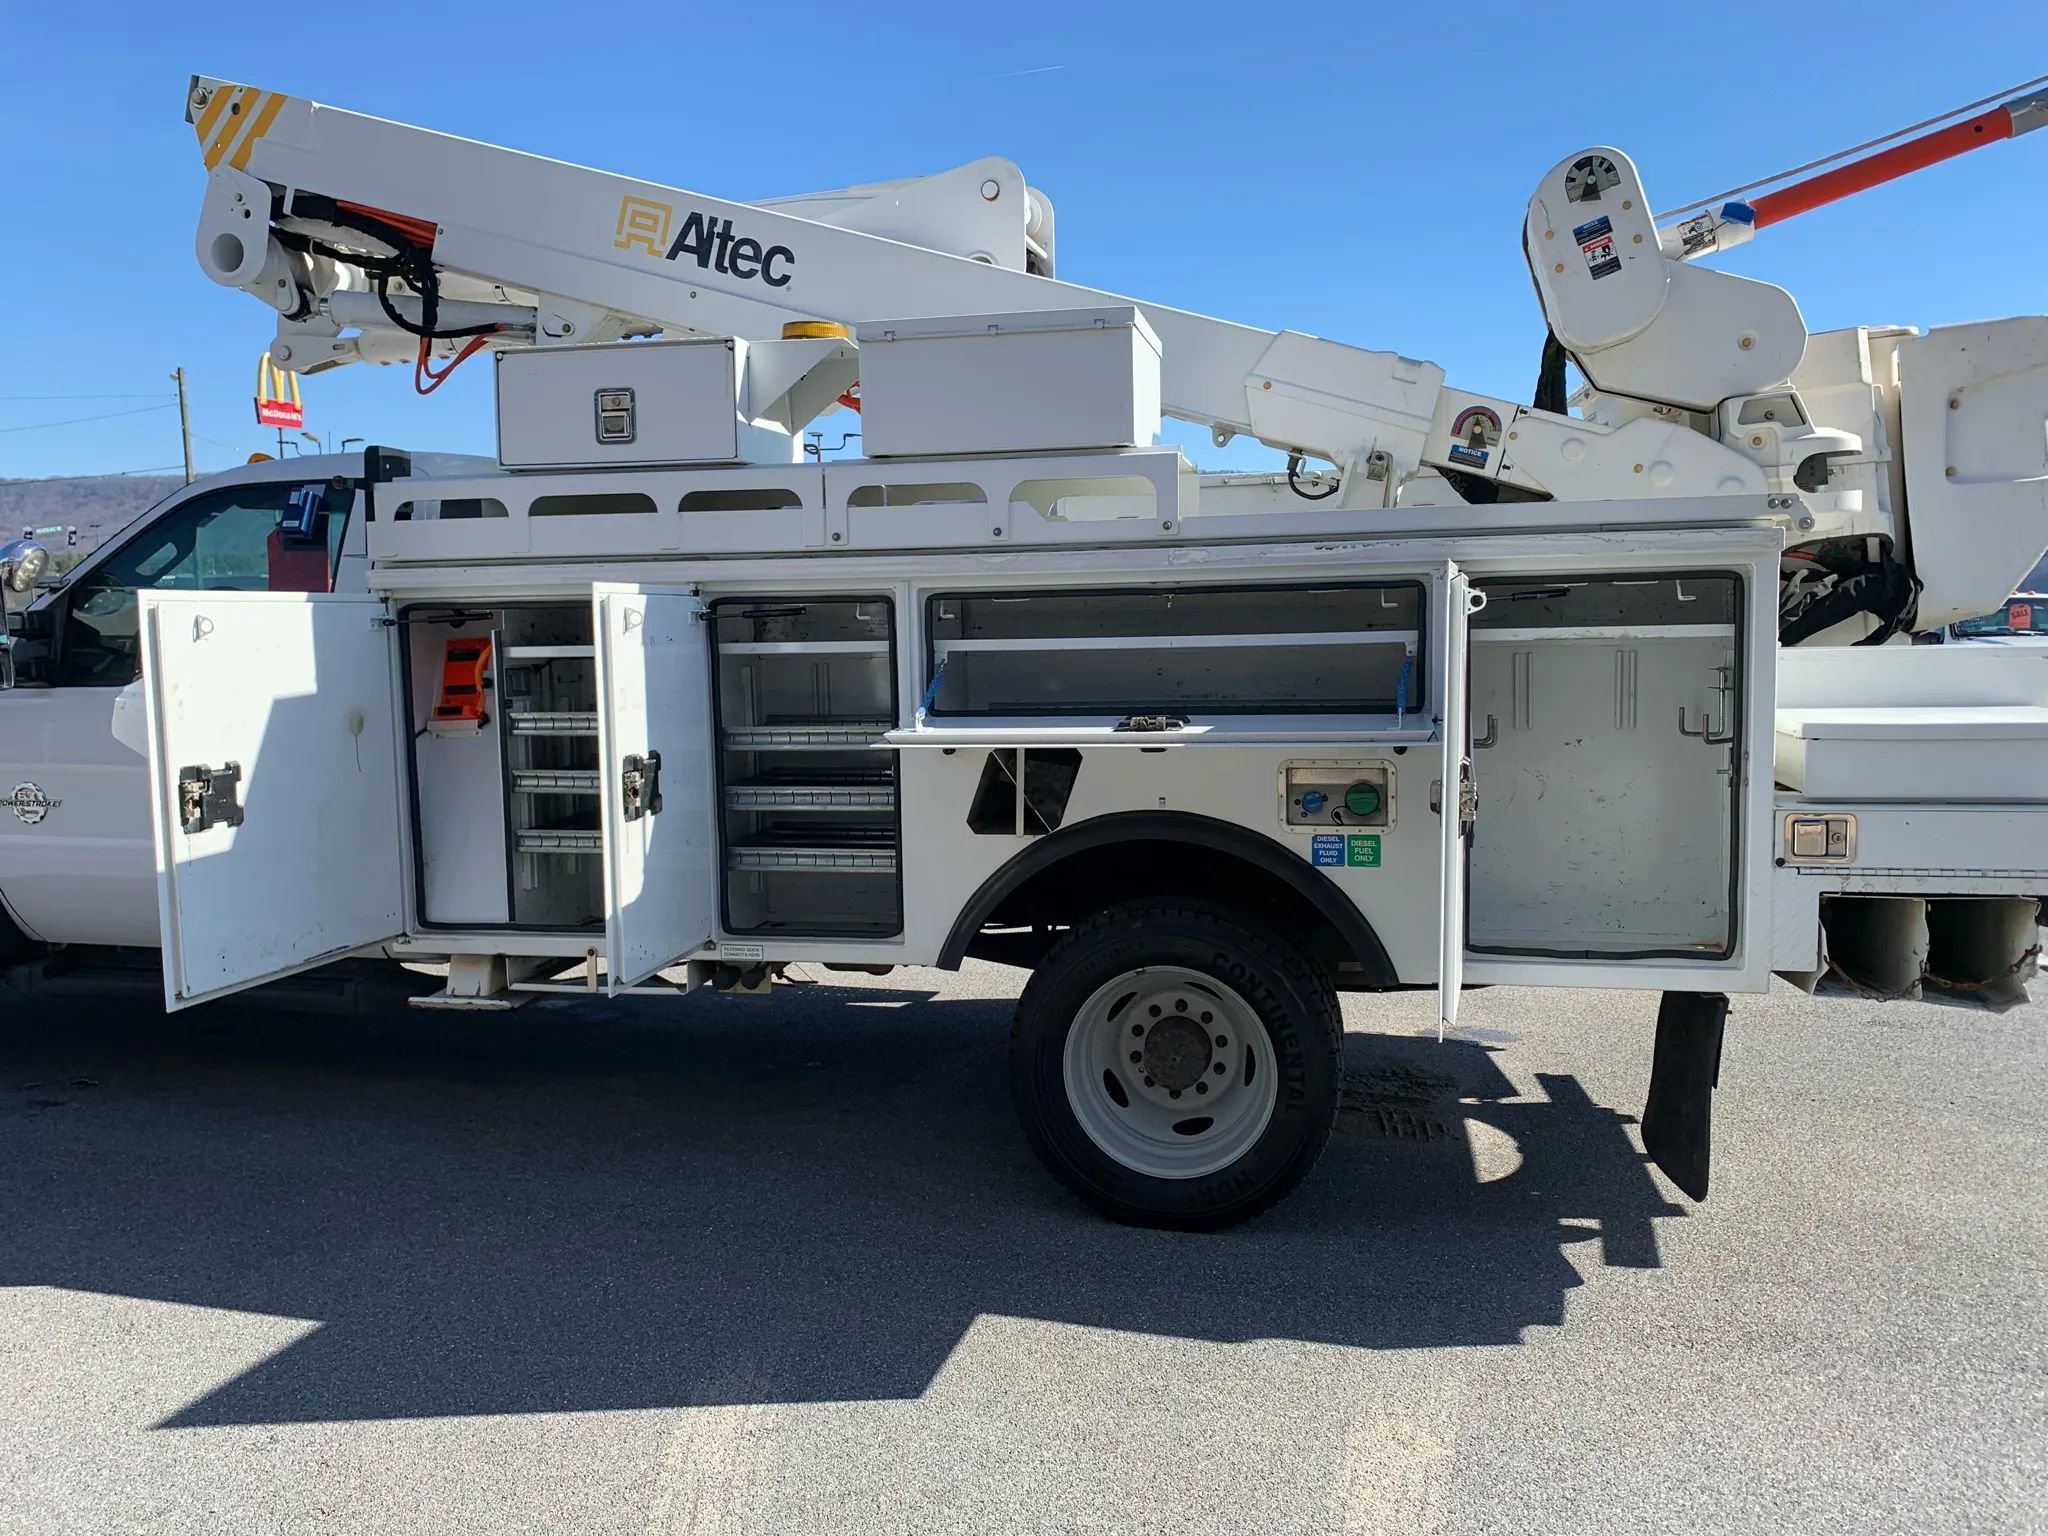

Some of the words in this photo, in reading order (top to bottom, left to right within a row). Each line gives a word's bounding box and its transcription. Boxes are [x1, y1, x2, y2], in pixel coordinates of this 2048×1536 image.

[665, 211, 795, 287] Altec
[262, 408, 302, 422] McDonald's
[1458, 446, 1482, 457] NOTICE
[2010, 608, 2029, 619] SALE
[25, 800, 61, 808] STROKE
[1354, 847, 1374, 855] FUEL
[1354, 854, 1374, 862] ONLY
[1211, 952, 1306, 1113] CONTINENTAL
